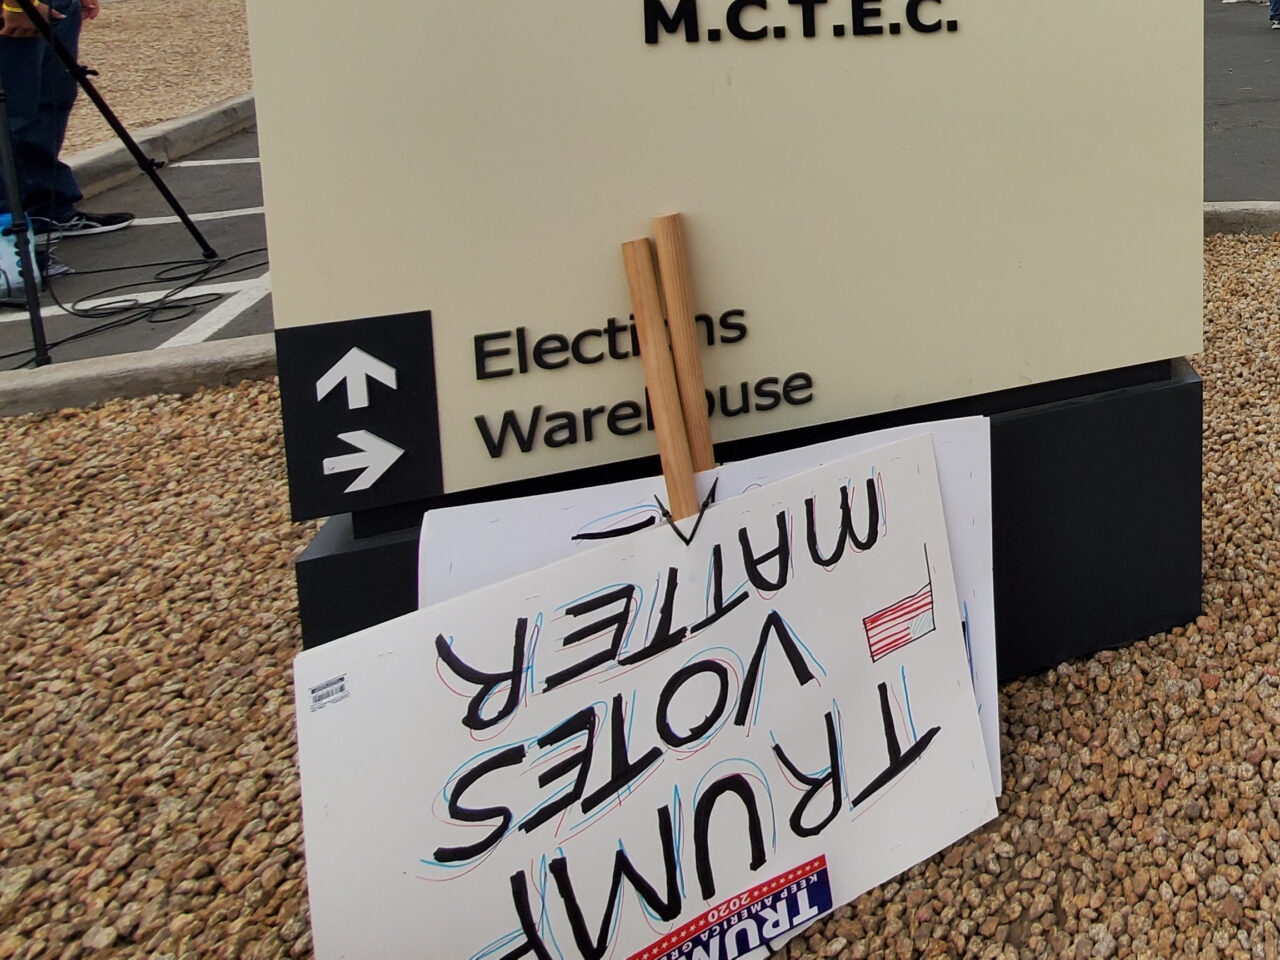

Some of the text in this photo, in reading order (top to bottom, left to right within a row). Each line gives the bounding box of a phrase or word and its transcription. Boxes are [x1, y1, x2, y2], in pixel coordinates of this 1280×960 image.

[474, 308, 748, 381] Electins
[474, 371, 815, 459] Wareuse
[434, 477, 880, 731] MATTER
[432, 609, 815, 862] VOTES
[700, 896, 774, 942] AMERICA
[707, 893, 752, 923] 2020
[780, 873, 819, 898] KEEP
[677, 887, 819, 960] TRUM
